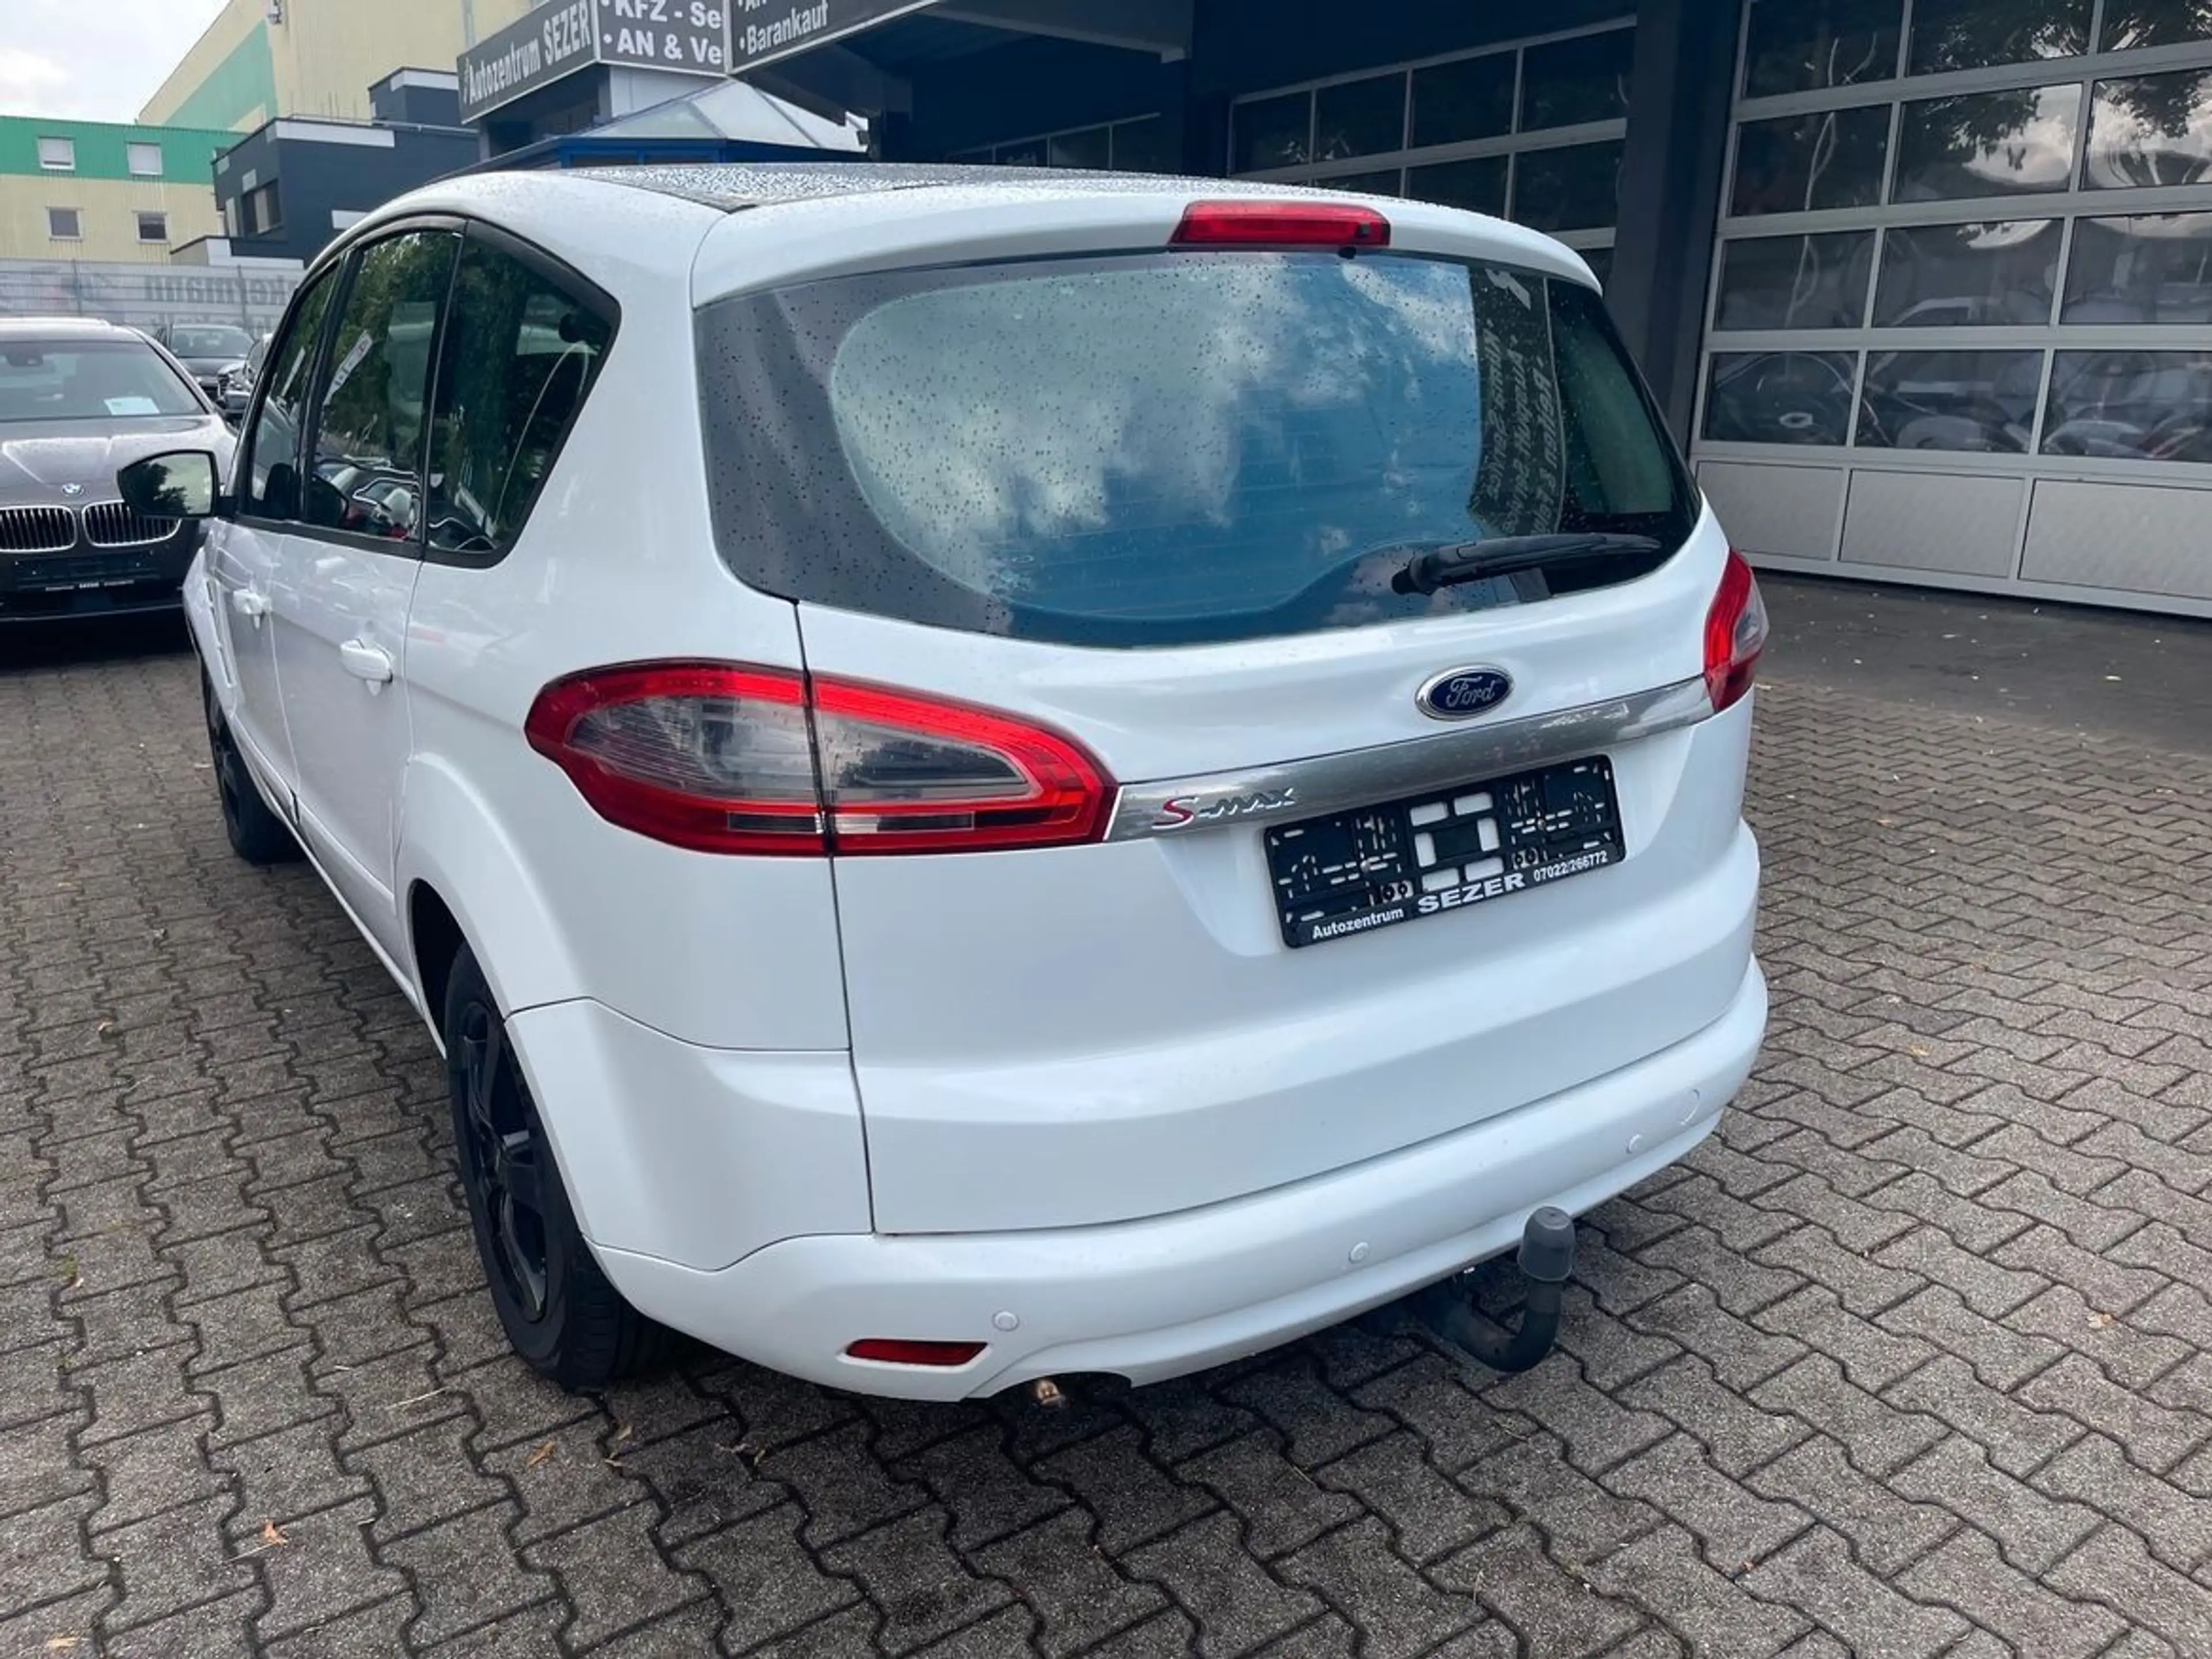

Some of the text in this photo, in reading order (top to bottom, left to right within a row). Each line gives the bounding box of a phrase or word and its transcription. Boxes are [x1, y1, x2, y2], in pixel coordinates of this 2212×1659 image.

[615, 0, 668, 22] KFZ
[747, 0, 828, 55] Barankauf
[468, 0, 592, 105] Autozentrum SEZER
[617, 28, 655, 58] AN
[664, 33, 683, 60] &
[1446, 676, 1496, 707] Ford
[1312, 906, 1404, 940] Autozentrum
[1416, 872, 1527, 914] SEZER
